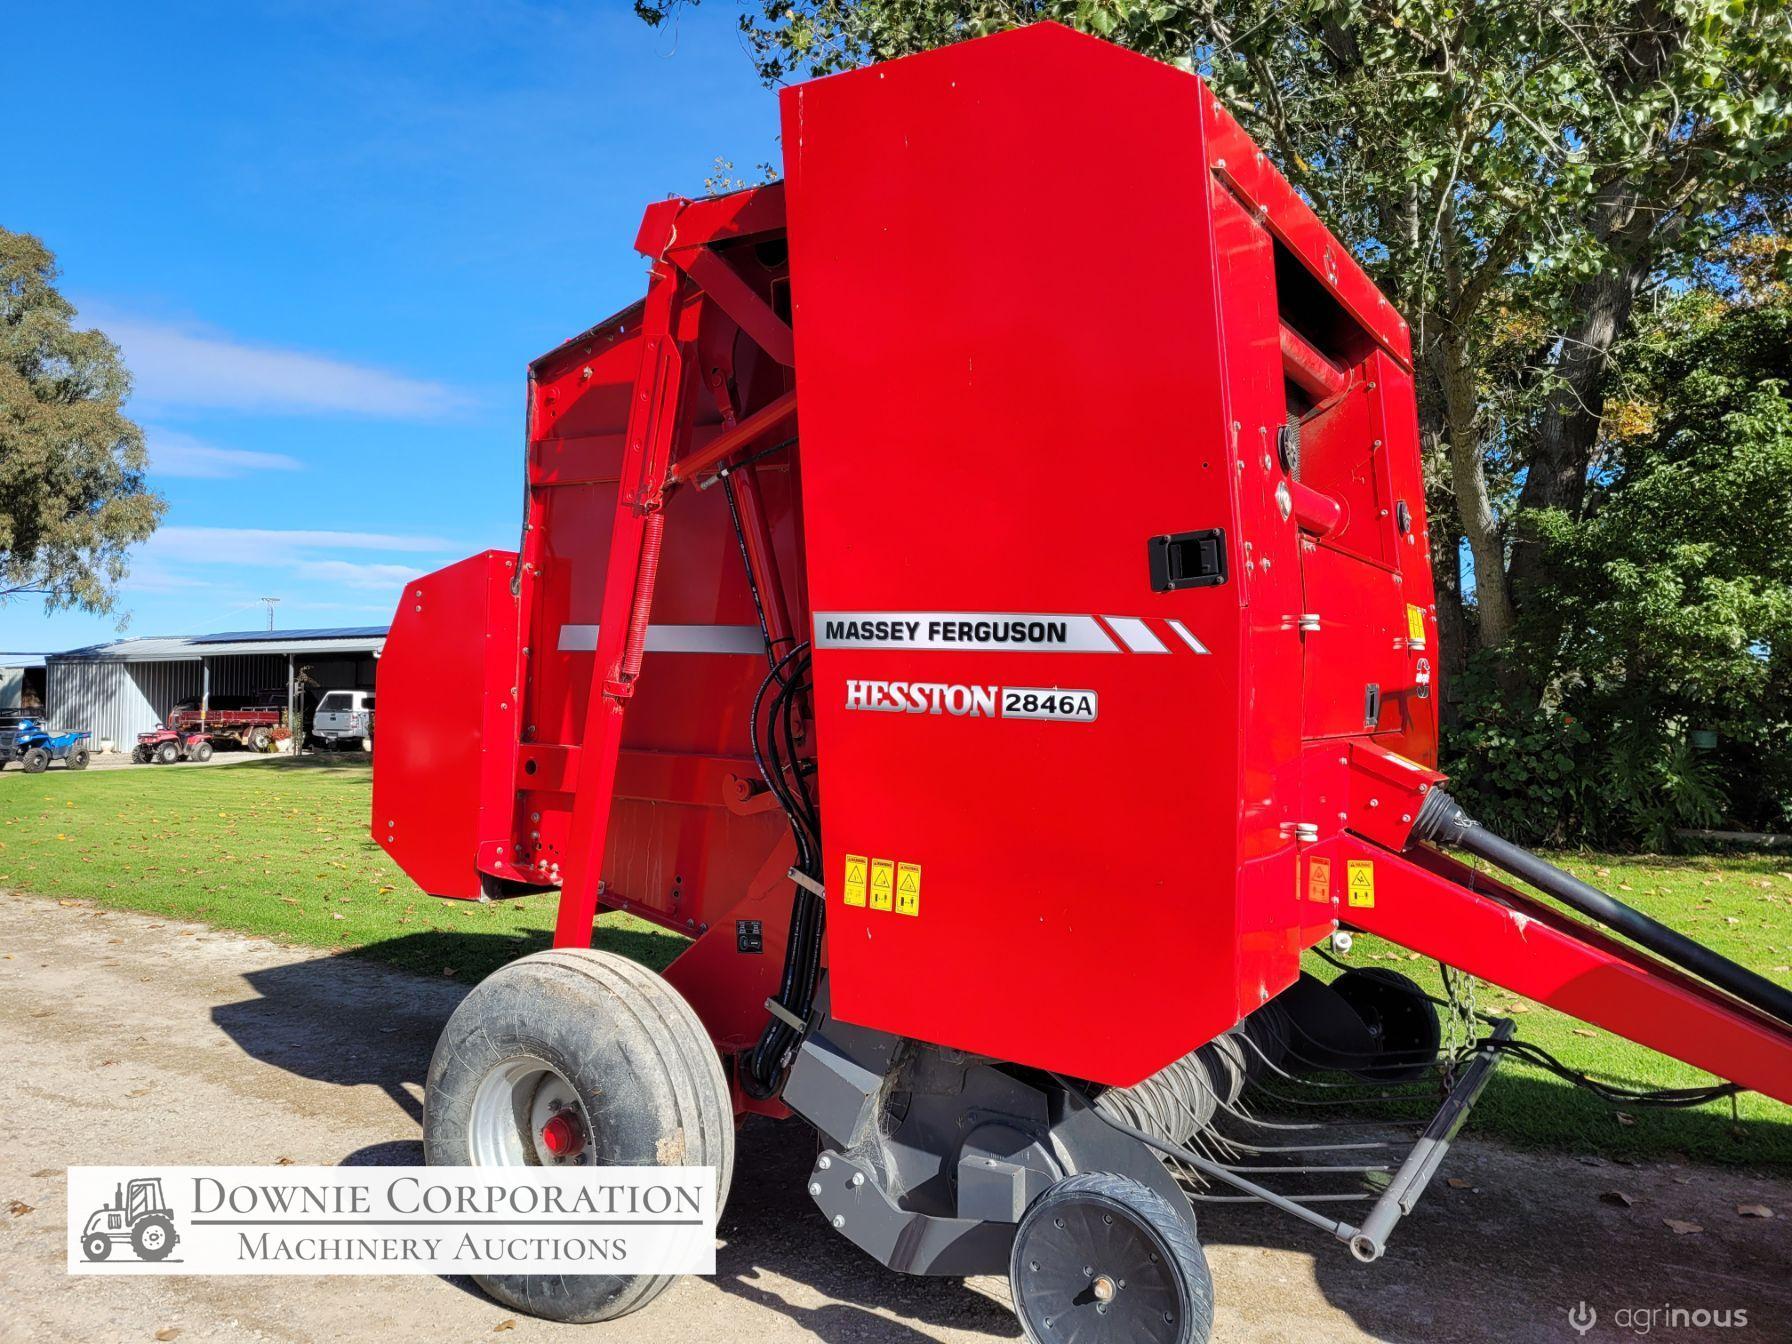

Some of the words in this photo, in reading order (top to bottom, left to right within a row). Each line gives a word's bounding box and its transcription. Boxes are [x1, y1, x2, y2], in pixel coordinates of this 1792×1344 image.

[825, 621, 920, 641] MASSEY
[928, 622, 1067, 643] FERGUSON
[845, 680, 998, 718] HESSTON
[1005, 693, 1092, 716] 2846A
